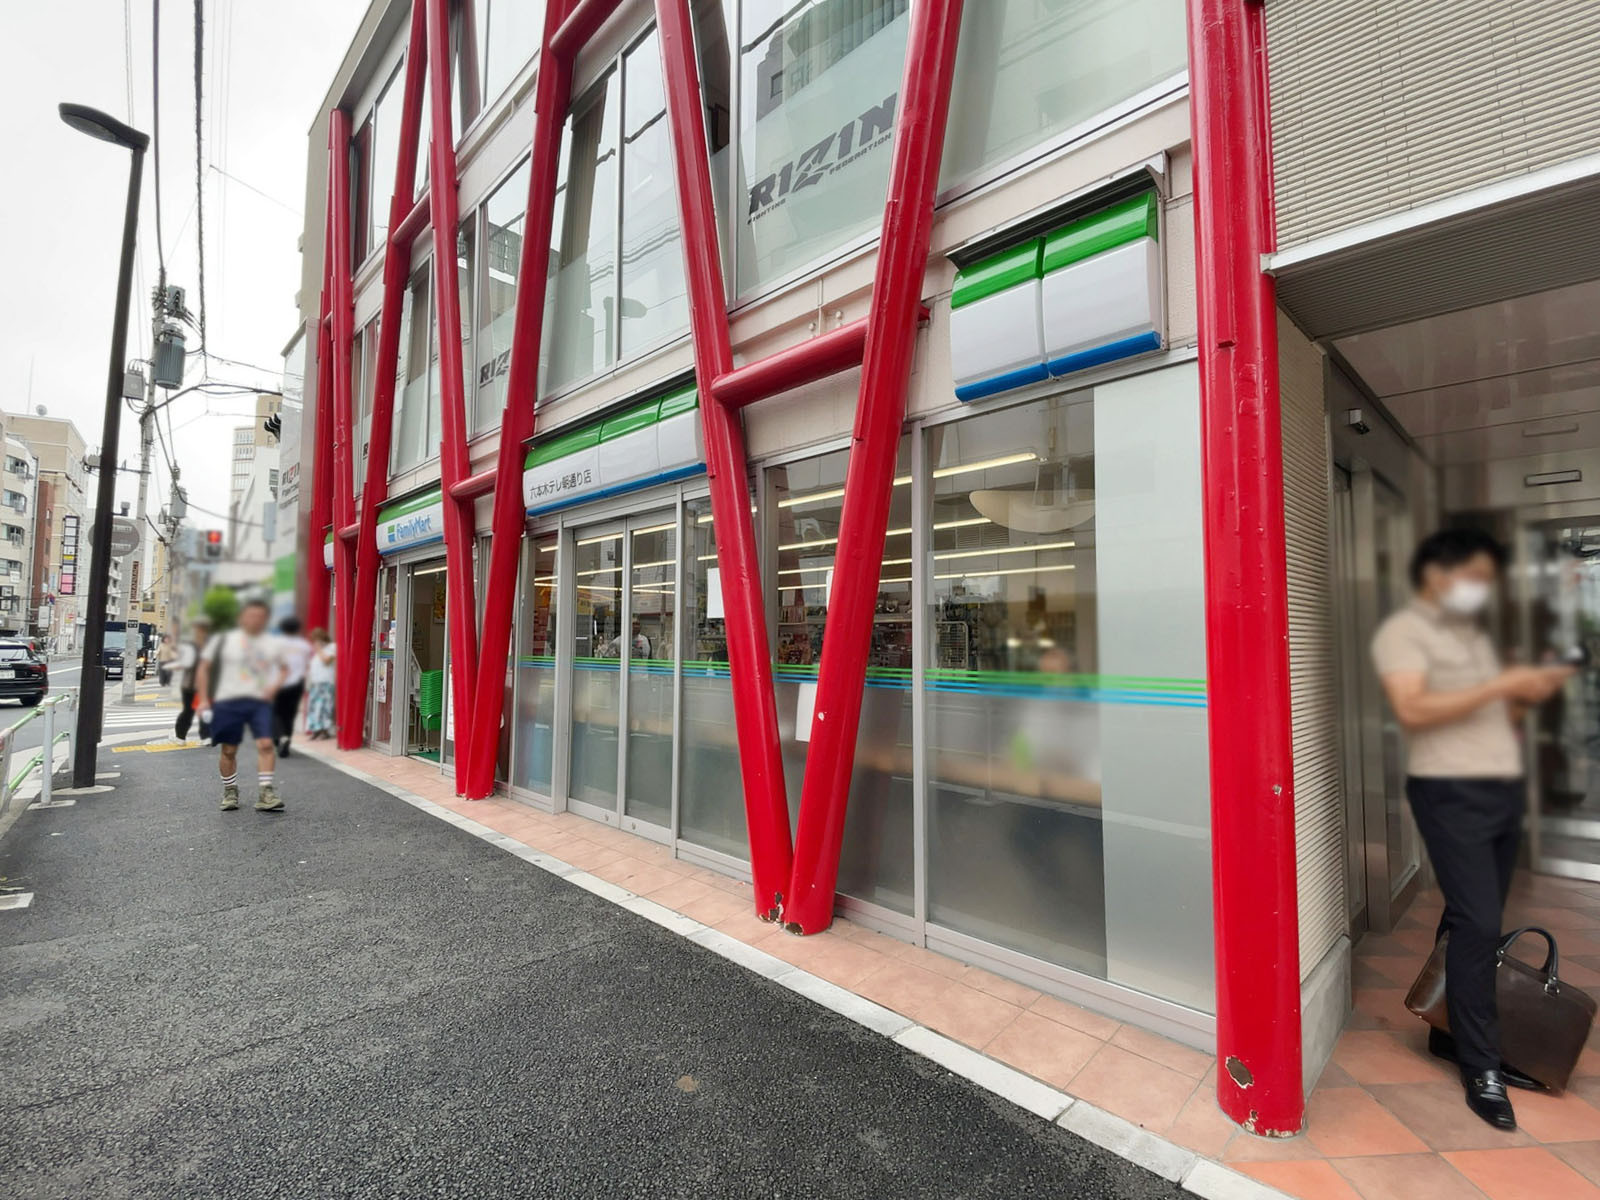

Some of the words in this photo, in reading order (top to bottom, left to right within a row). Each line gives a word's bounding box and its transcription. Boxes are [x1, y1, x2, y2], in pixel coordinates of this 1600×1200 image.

[748, 92, 898, 216] RIZIN
[829, 132, 892, 175] FEDERATION
[529, 469, 592, 500] 六本木テレ朝通り店
[396, 513, 433, 541] FamilyMart
